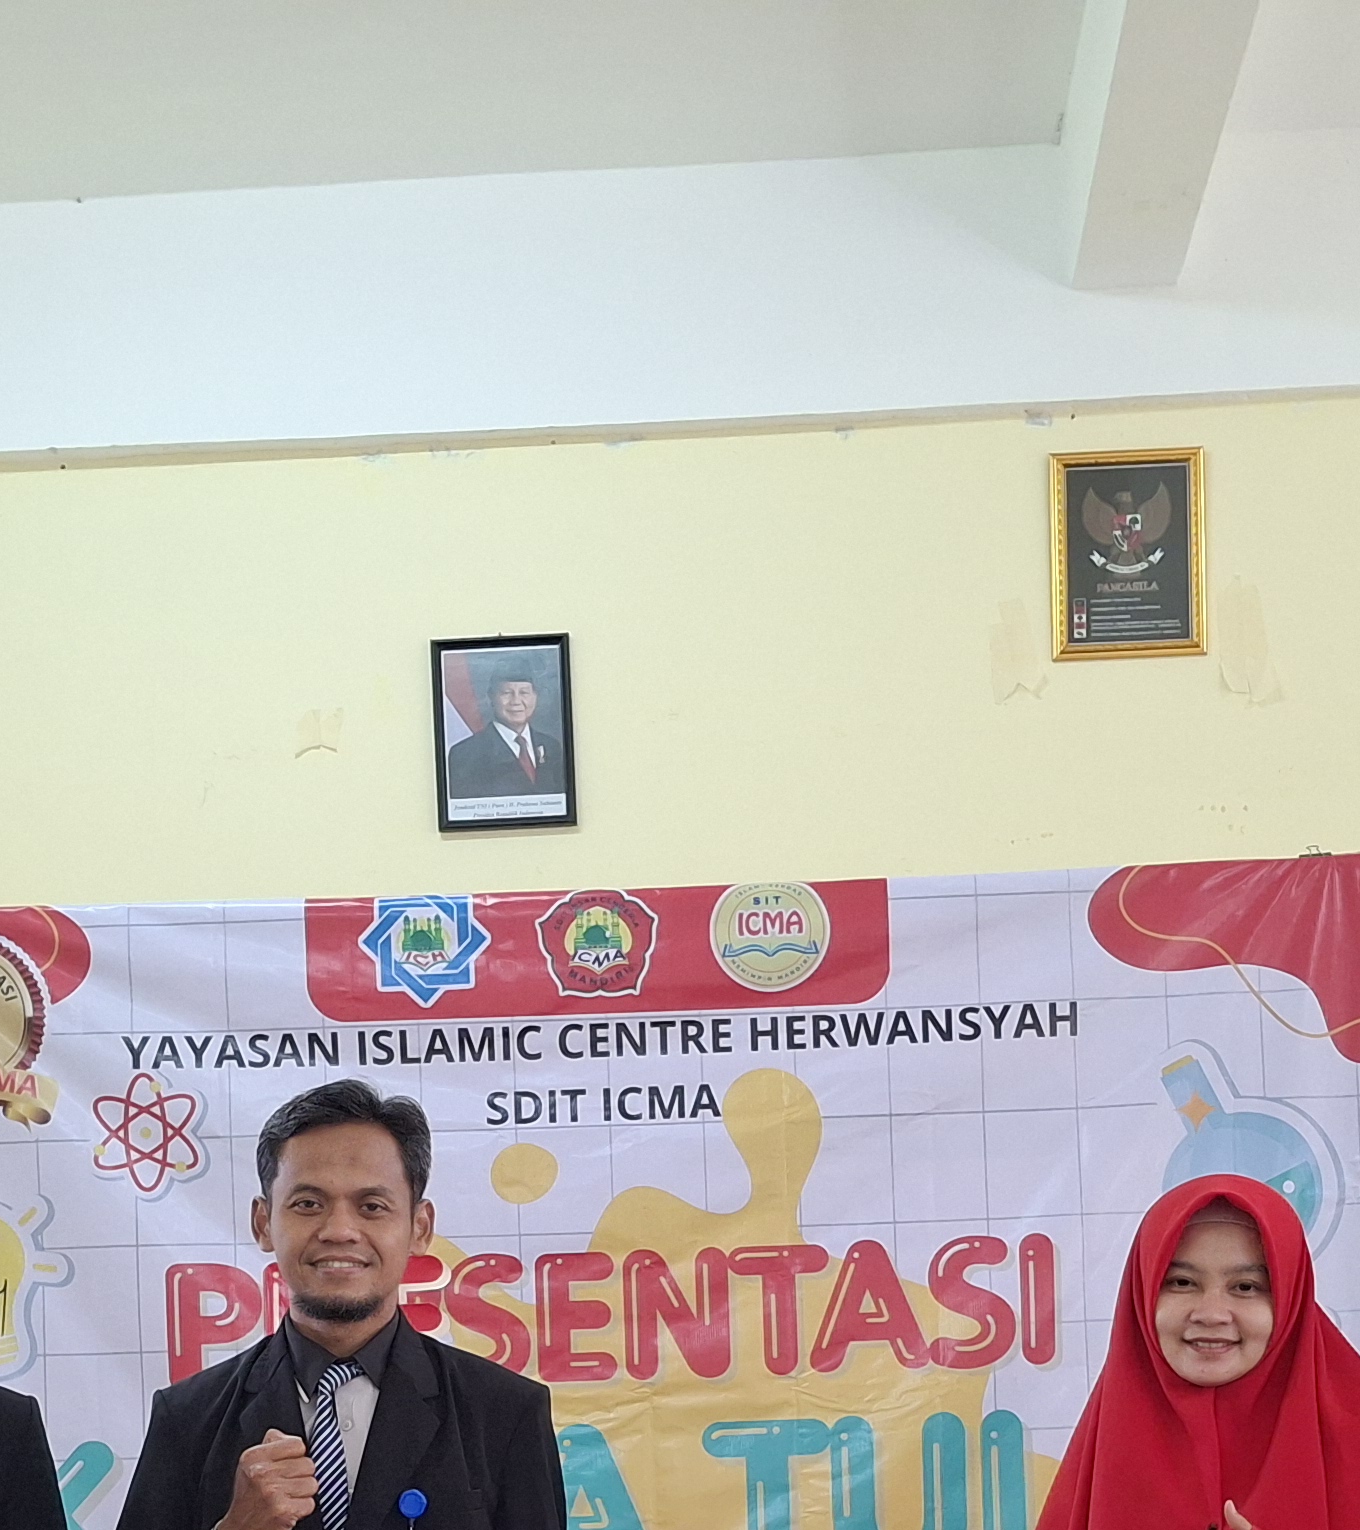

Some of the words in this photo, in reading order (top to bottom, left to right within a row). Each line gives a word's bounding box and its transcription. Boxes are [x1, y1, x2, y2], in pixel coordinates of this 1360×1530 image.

[752, 896, 782, 906] SIT
[737, 910, 804, 937] ICMA
[405, 951, 446, 967] ICH
[571, 949, 626, 968] ICMA
[121, 1031, 339, 1070] YAYASAN
[357, 1024, 543, 1066] ISLAMIC
[557, 1018, 733, 1059] CENTRE
[749, 1001, 1078, 1052] HERWANSYAH
[485, 1088, 587, 1127] SDIT
[602, 1083, 722, 1122] ICMA
[165, 1232, 1056, 1385] PSENTASI
